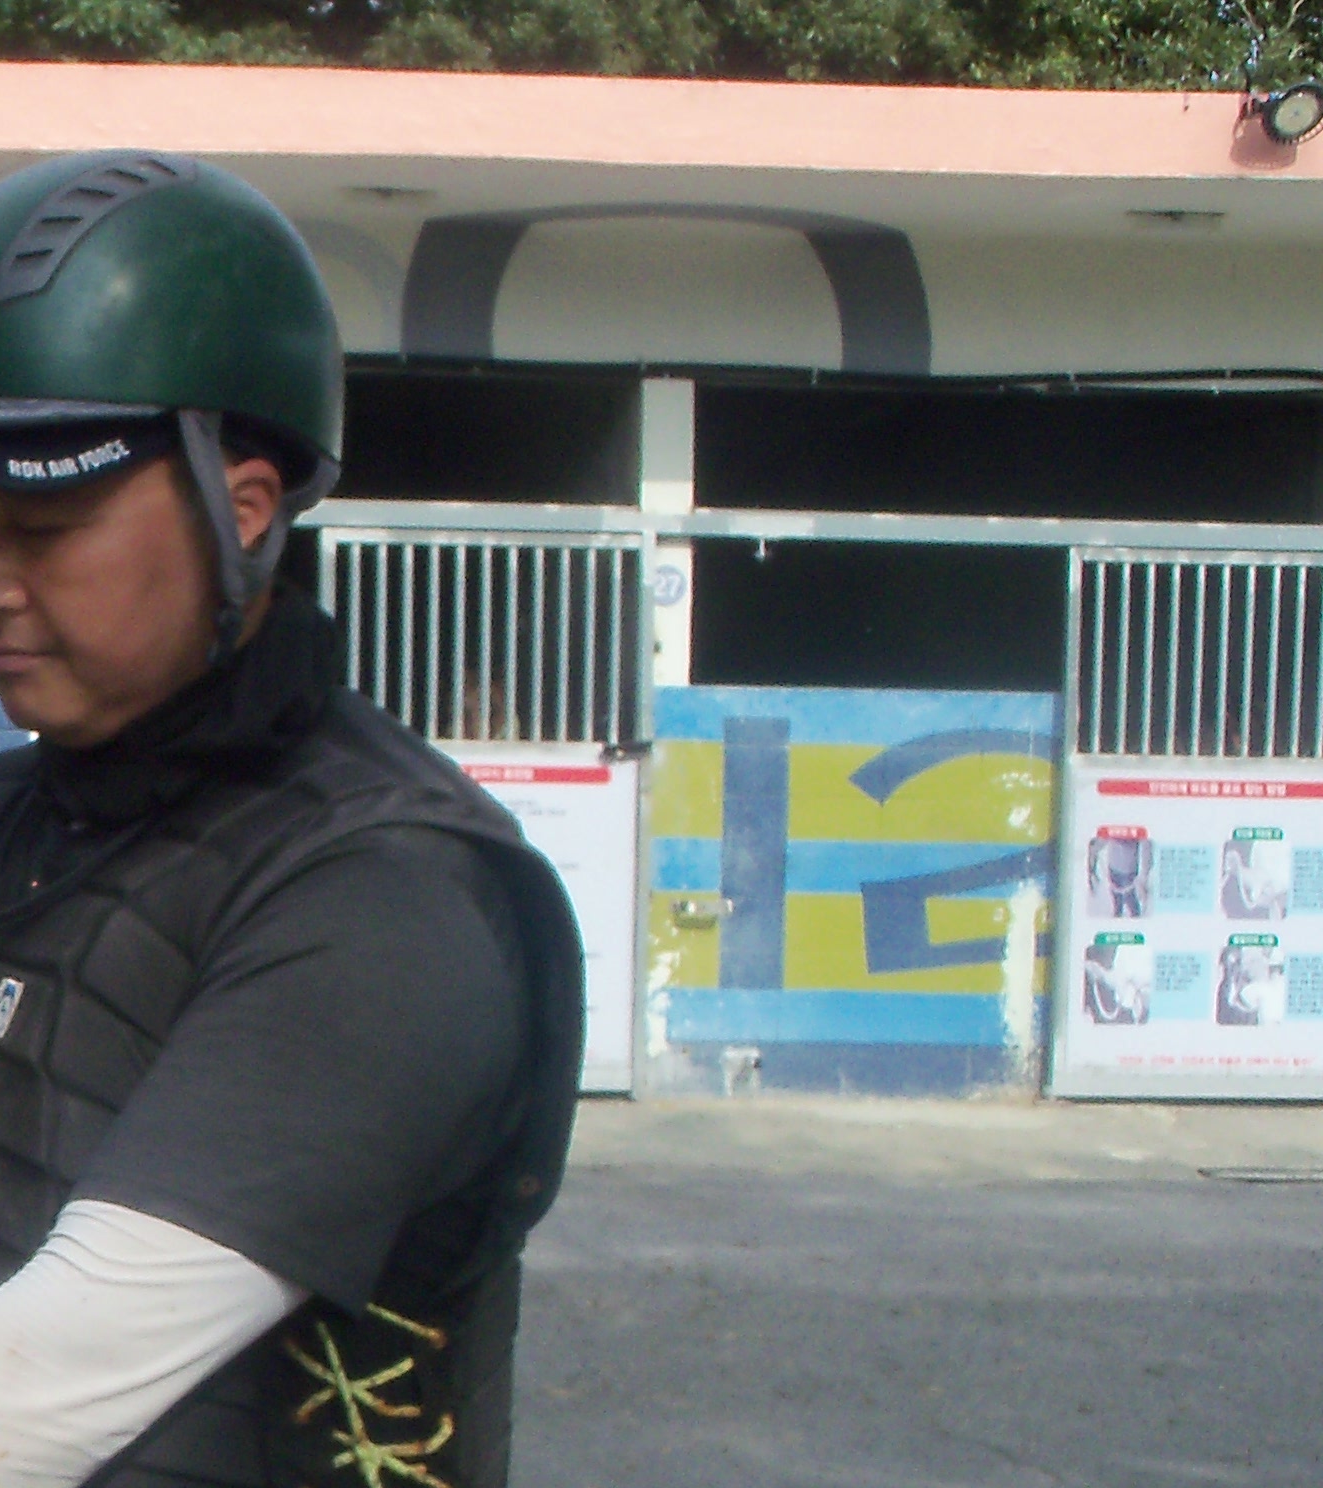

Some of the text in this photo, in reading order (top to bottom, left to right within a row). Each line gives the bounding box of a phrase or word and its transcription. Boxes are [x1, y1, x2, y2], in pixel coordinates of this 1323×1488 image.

[8, 439, 131, 479] ROK AIR FORCE
